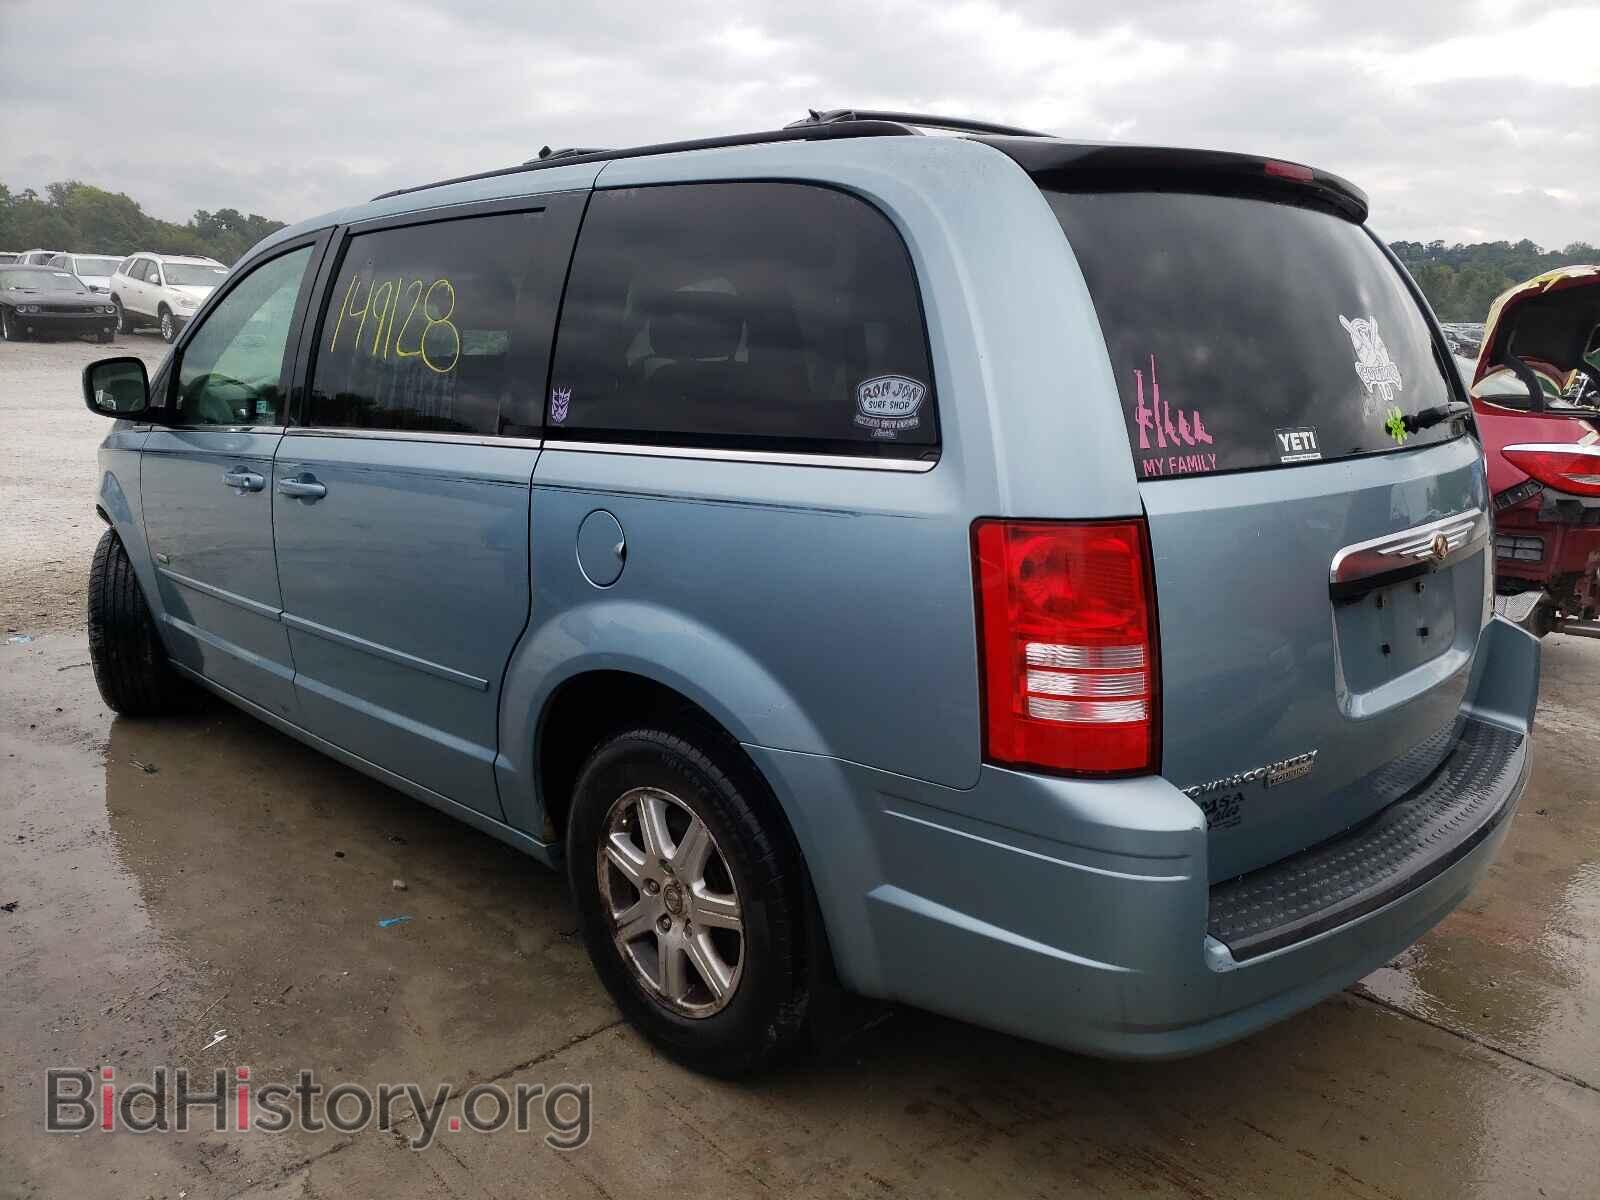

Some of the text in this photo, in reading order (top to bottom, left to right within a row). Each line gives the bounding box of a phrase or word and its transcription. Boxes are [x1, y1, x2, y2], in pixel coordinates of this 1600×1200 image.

[331, 274, 460, 373] 149128
[863, 382, 920, 402] RON JON
[868, 400, 910, 411] SURF SHOP
[1277, 431, 1317, 452] YETI
[1142, 453, 1217, 477] MY FAMILY
